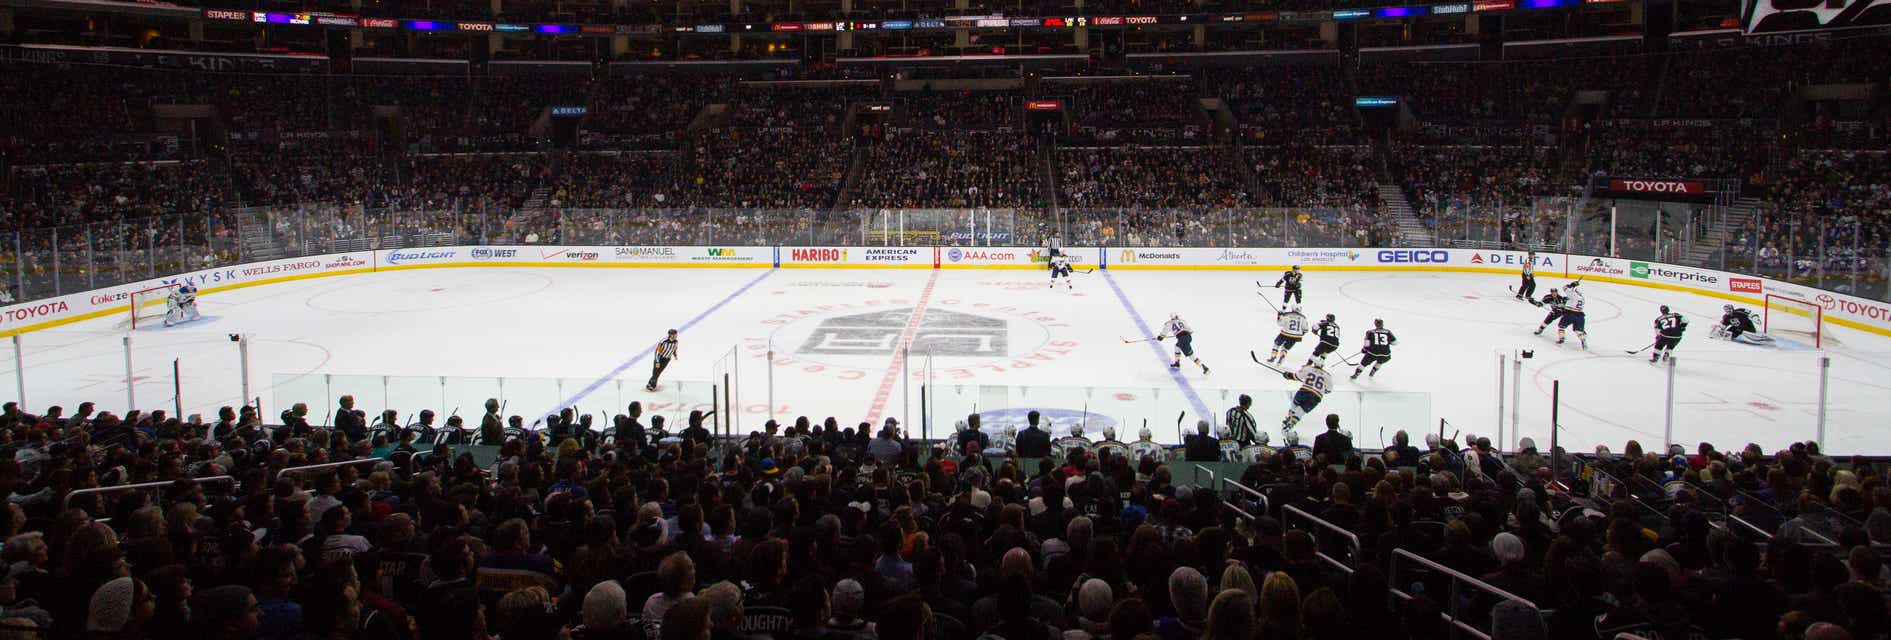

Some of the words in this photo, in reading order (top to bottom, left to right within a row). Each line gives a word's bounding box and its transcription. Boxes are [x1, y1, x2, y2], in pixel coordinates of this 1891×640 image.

[207, 10, 245, 20] STAPLES
[458, 23, 493, 31] TOYOTA
[803, 23, 833, 31] TOSHIBA
[1623, 180, 1687, 193] TOYOTA
[391, 251, 420, 261] BUD
[420, 250, 456, 260] LIGHT
[494, 249, 517, 257] WEST
[566, 250, 599, 260] verizon
[639, 247, 675, 255] MANUEL
[792, 249, 840, 261] HARIBO
[963, 251, 1015, 261] AAA.com
[1139, 252, 1181, 260] McDonald's
[1377, 250, 1449, 263] GEICO
[1490, 253, 1553, 266] DELTA
[242, 265, 281, 277] WELLS
[283, 261, 321, 272] FARGO
[1731, 281, 1761, 290] STAPLES
[91, 293, 116, 306] Coke
[6, 301, 69, 322] TOYOTA
[1838, 299, 1891, 322] TOYOT
[1289, 319, 1301, 332] 21
[1660, 317, 1677, 330] 27
[1374, 333, 1389, 346] 13
[1305, 373, 1325, 390] 26
